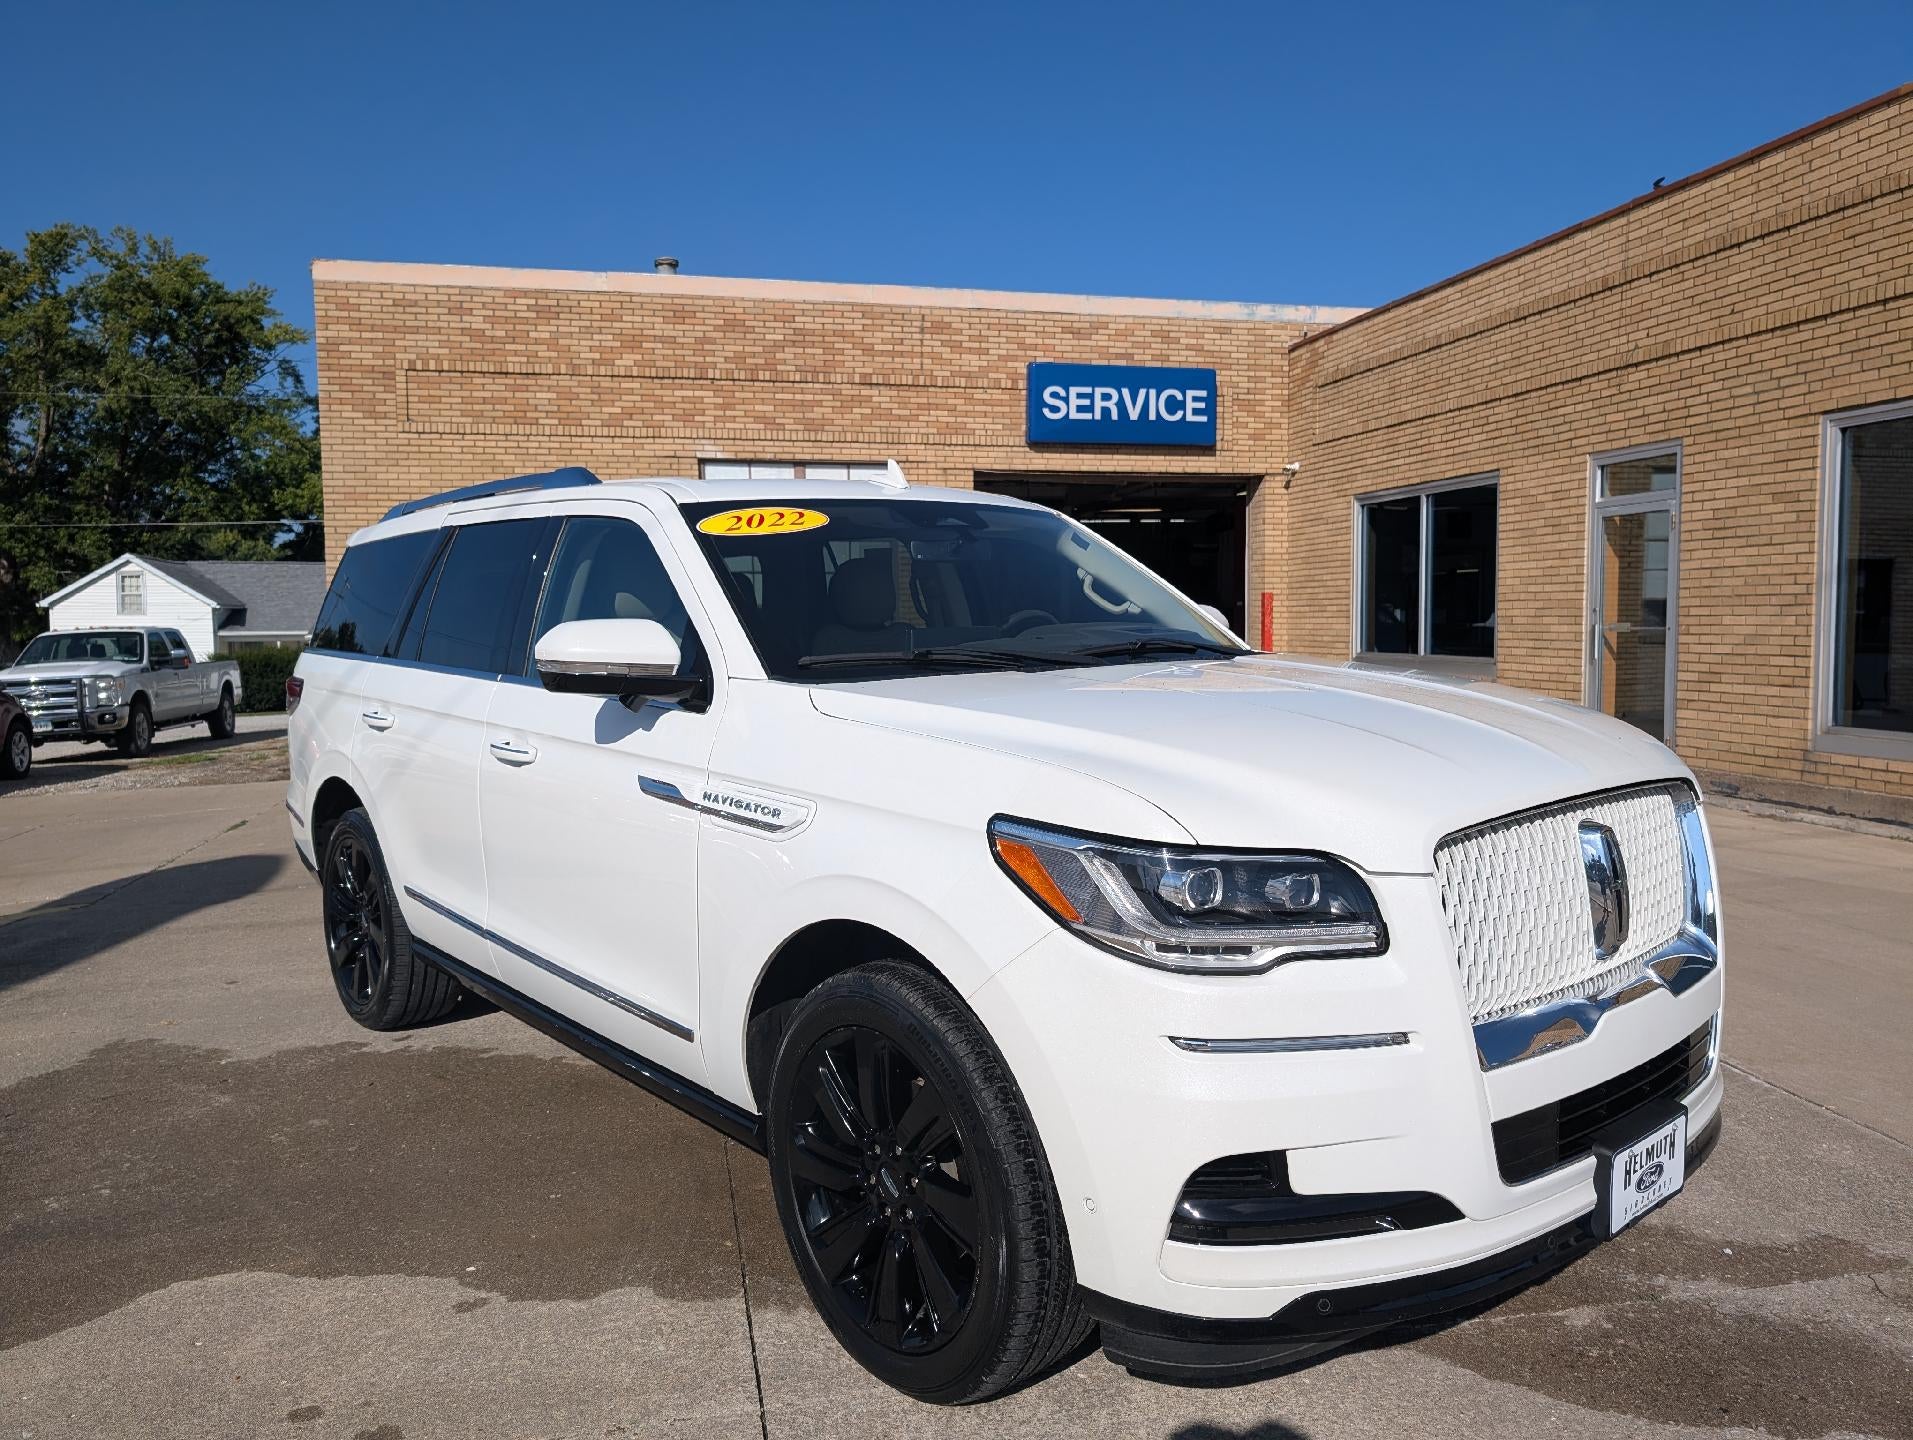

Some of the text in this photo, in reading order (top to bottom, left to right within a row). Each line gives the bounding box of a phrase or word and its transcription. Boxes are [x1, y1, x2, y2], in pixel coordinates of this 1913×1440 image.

[1042, 385, 1208, 422] SERVICE
[724, 511, 805, 532] 2022
[702, 790, 782, 820] NAVIGATOR
[1623, 1130, 1677, 1192] HELMUTH
